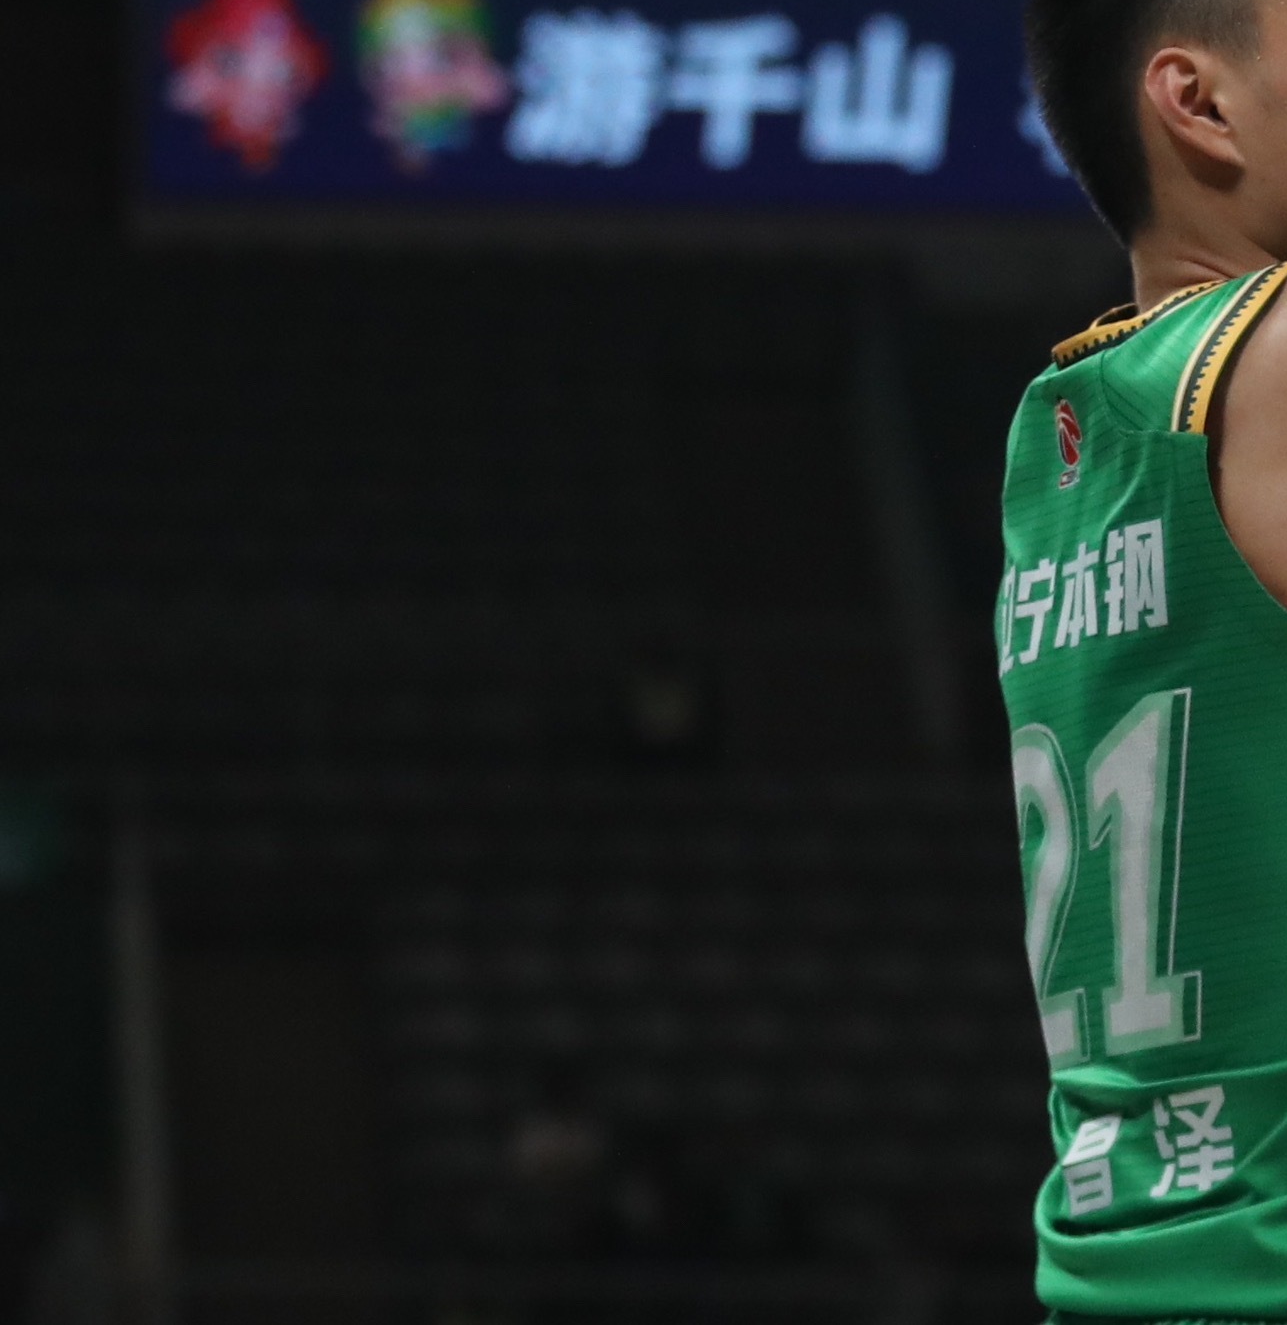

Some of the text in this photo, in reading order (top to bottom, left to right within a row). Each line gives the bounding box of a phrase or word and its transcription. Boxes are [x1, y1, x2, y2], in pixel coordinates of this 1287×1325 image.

[1000, 518, 1168, 677] 辽宁本钢
[1012, 687, 1201, 1071] 21
